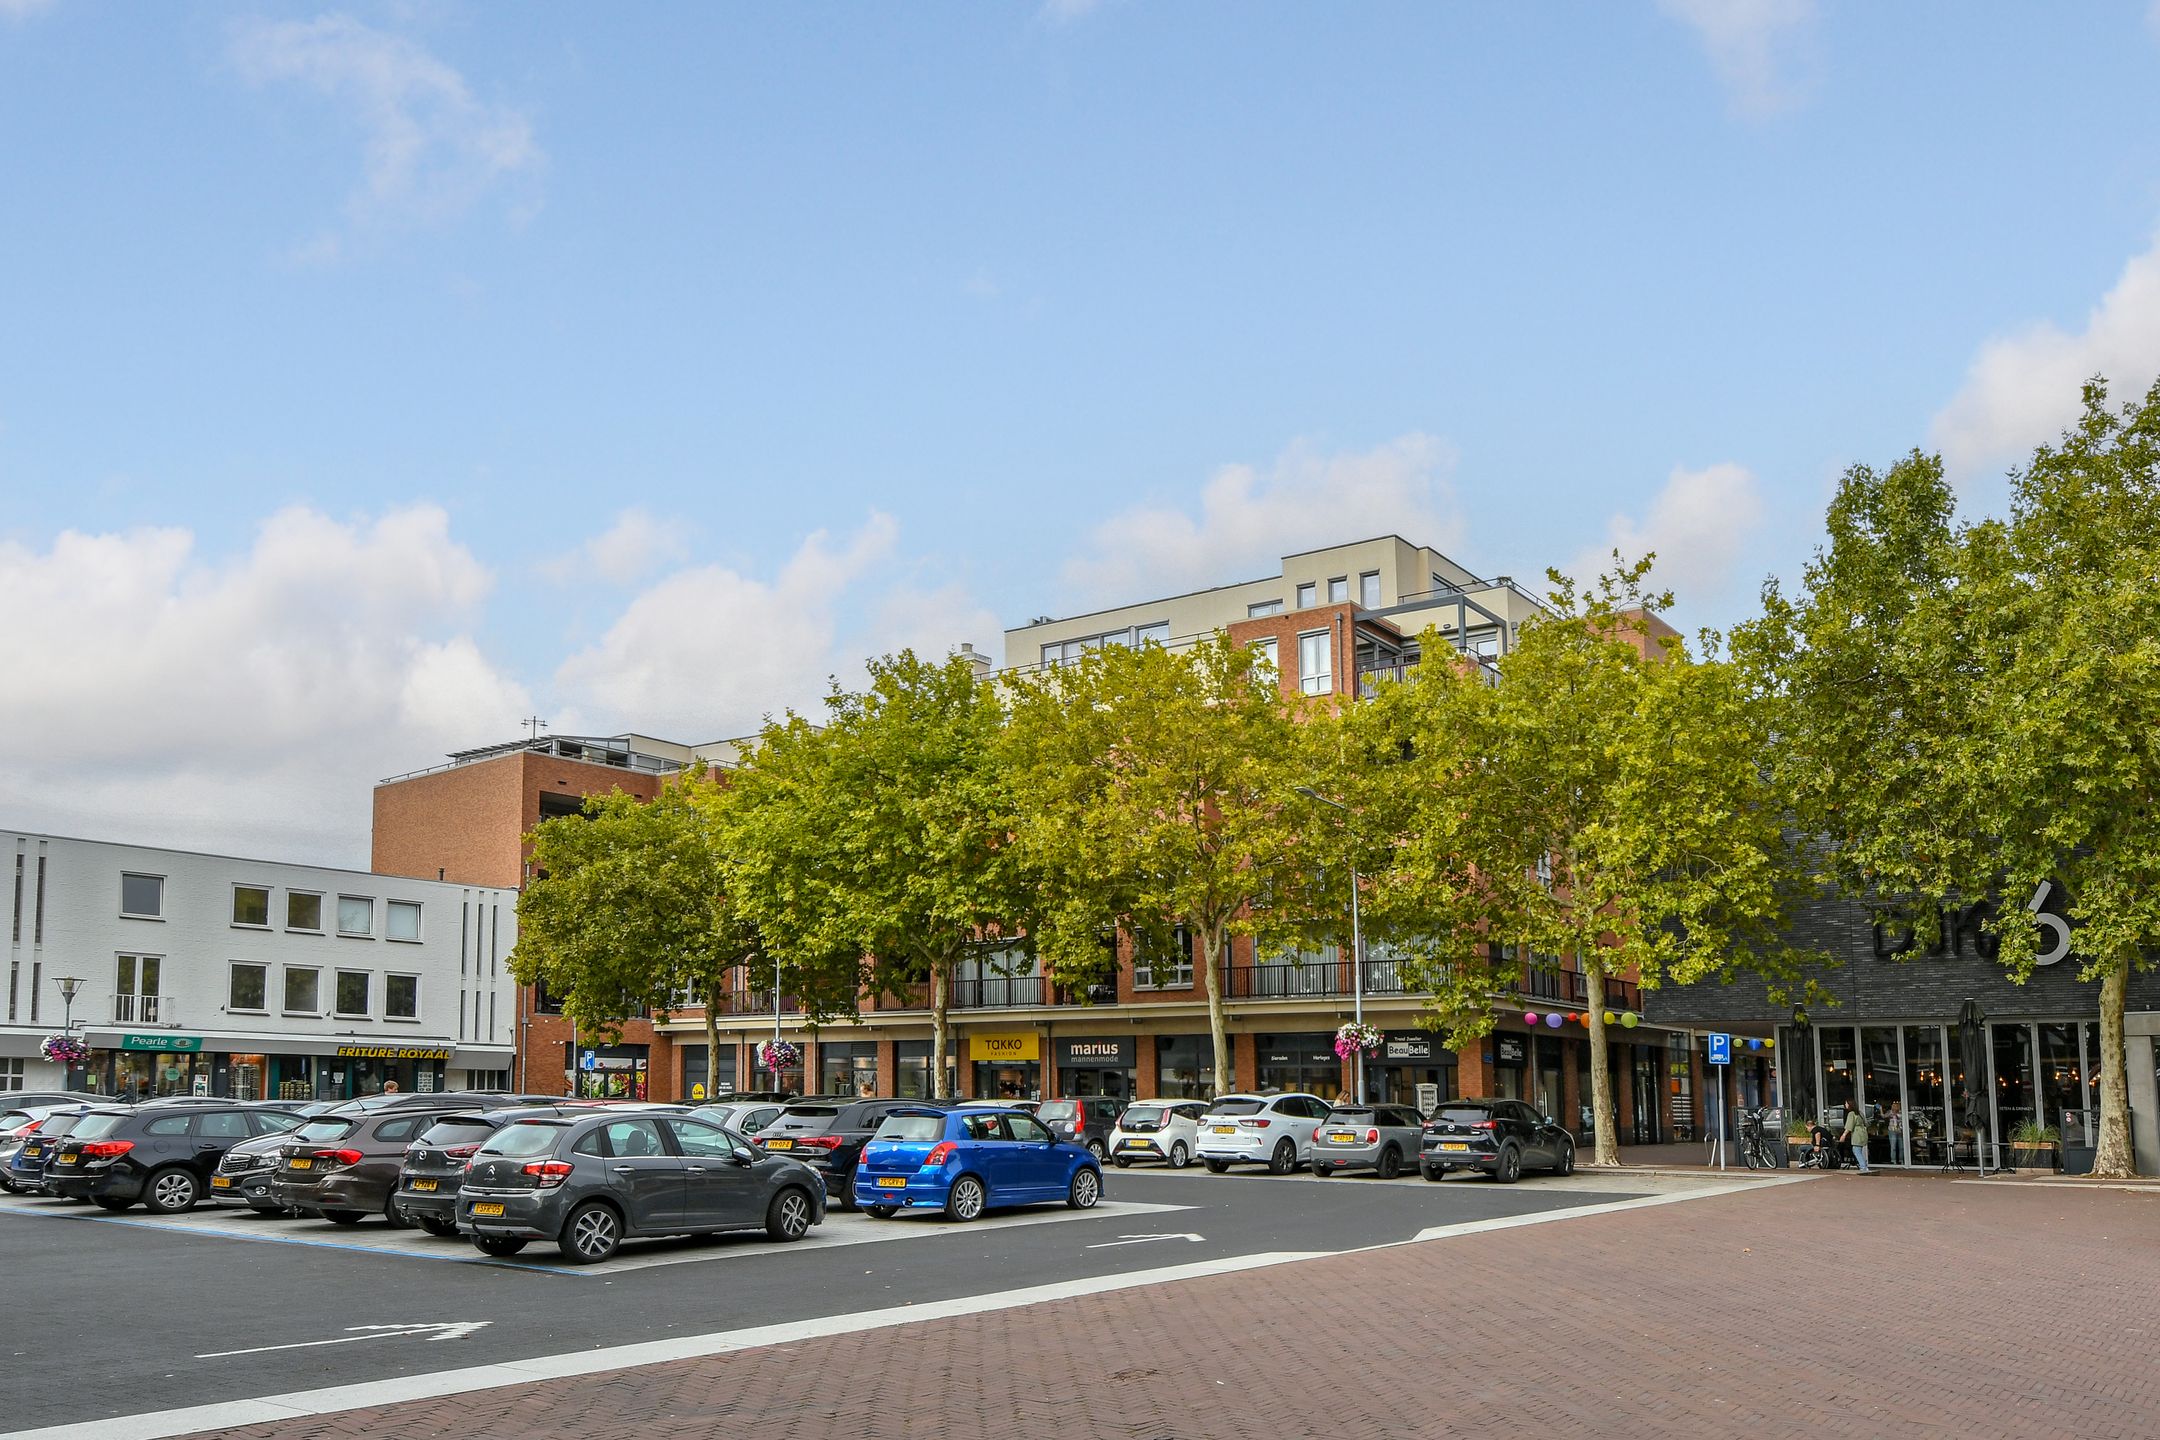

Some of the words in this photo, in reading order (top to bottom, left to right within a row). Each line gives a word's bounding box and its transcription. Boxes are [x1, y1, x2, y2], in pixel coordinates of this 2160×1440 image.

[131, 1036, 168, 1046] Pearle
[1070, 1041, 1119, 1055] marius
[1713, 1036, 1725, 1051] P
[338, 1046, 395, 1057] FRITURE
[398, 1048, 450, 1060] ROYAAL
